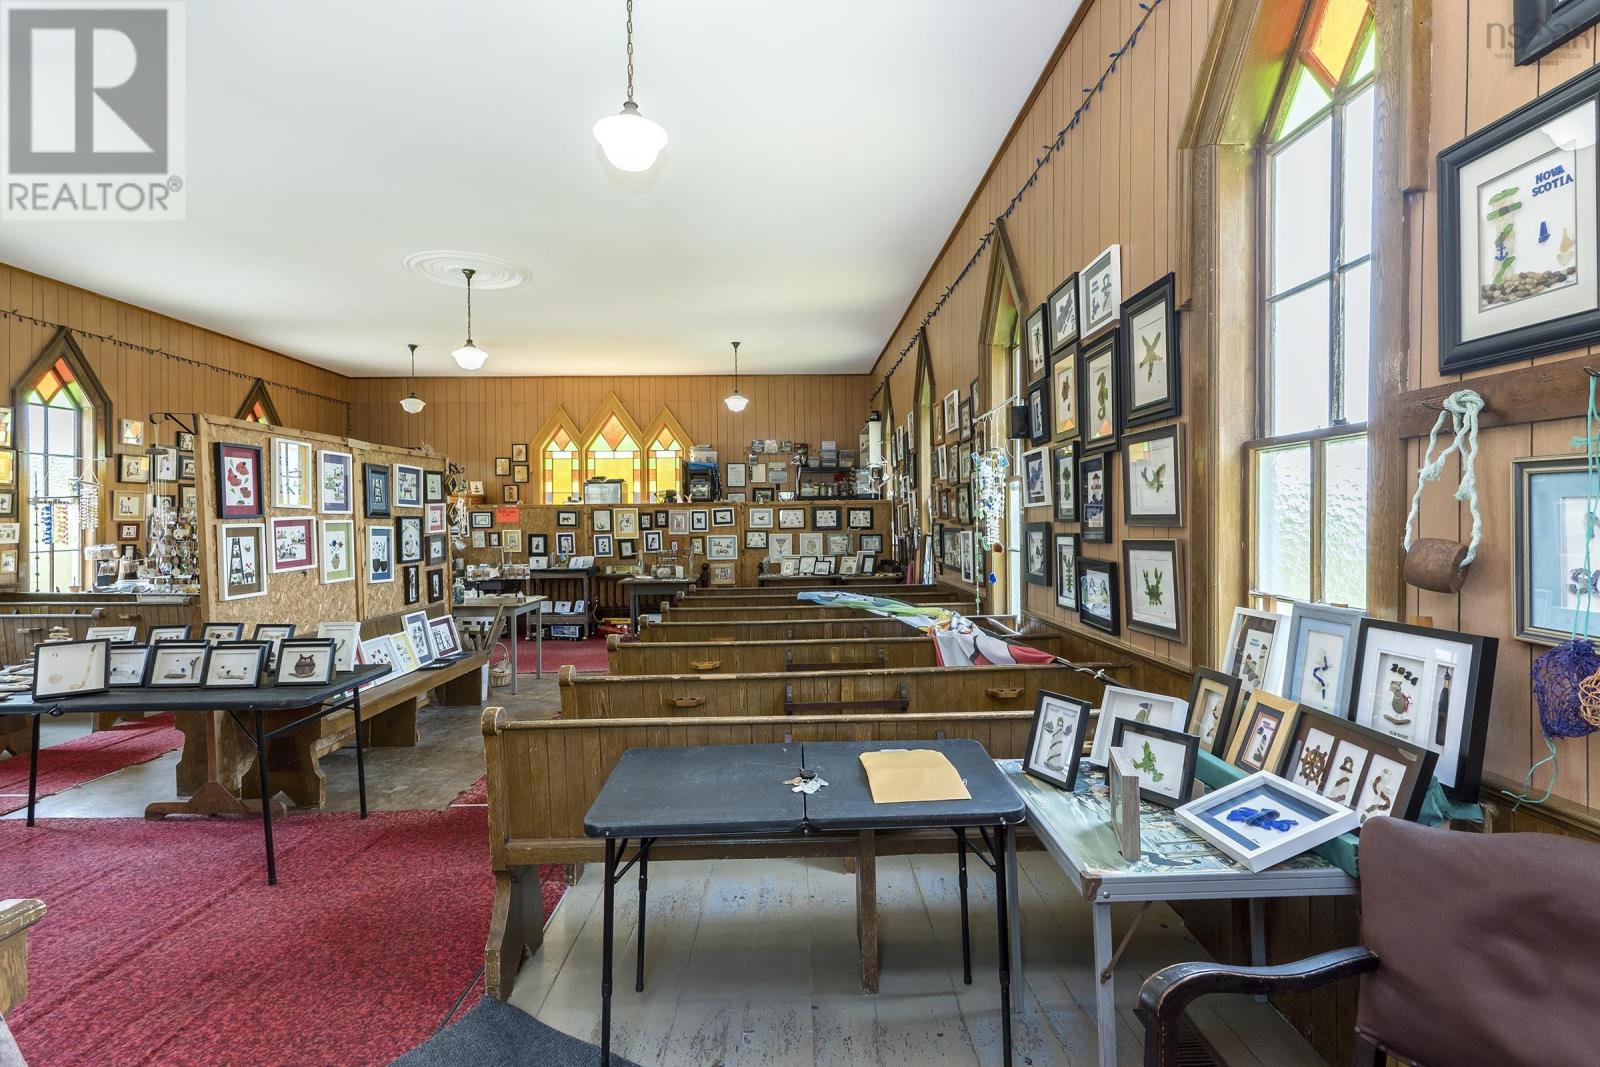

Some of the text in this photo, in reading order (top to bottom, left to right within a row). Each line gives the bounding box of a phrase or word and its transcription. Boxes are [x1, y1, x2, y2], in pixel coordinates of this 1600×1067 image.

[1531, 173, 1574, 197] SCOTIA
[1535, 164, 1565, 185] NOVA
[1390, 663, 1419, 686] 2024
